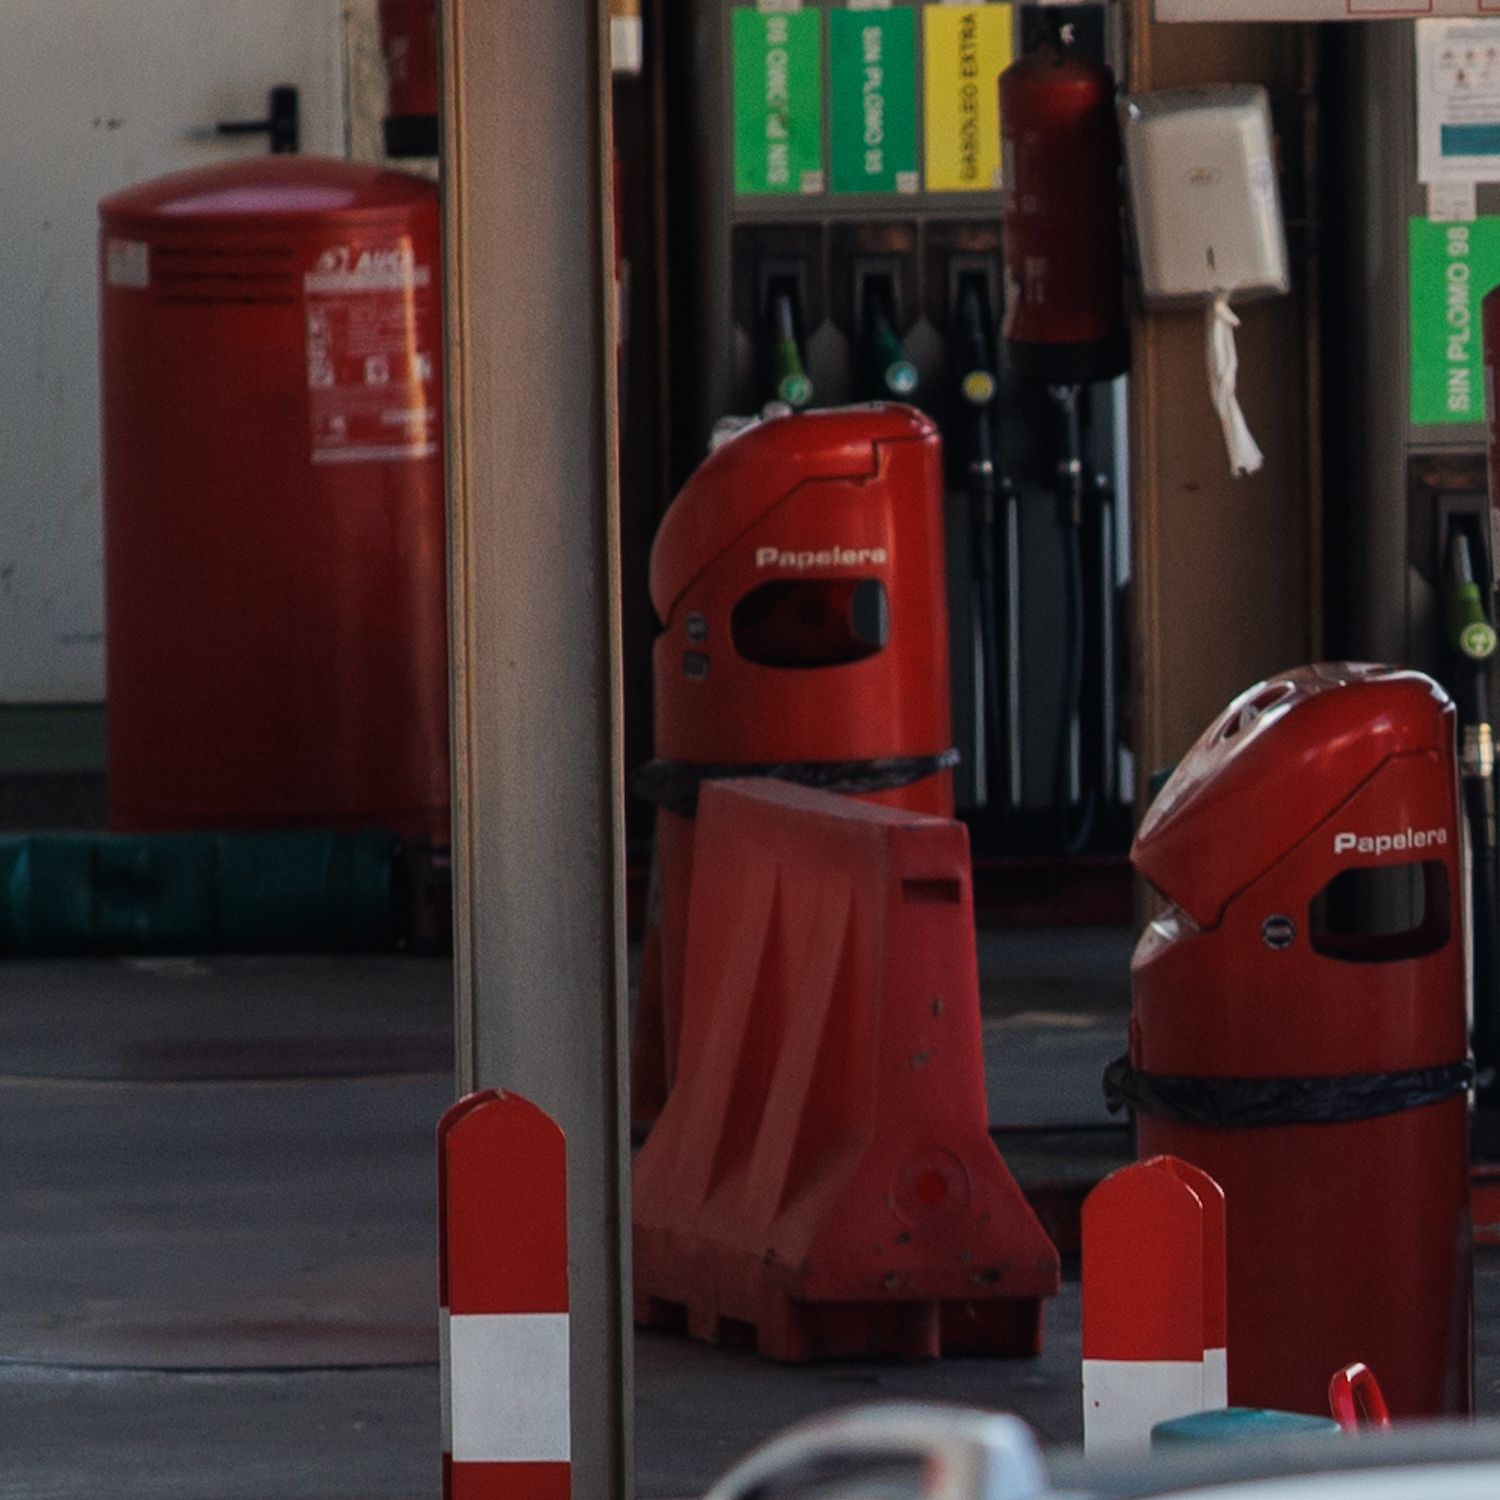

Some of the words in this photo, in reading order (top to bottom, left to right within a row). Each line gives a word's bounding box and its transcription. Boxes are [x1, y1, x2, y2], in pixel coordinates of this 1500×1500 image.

[1447, 227, 1470, 257] 98
[1447, 264, 1470, 361] PLOMO
[1447, 368, 1470, 411] SIN
[756, 545, 888, 571] Papelera
[1334, 825, 1448, 856] Papelera
